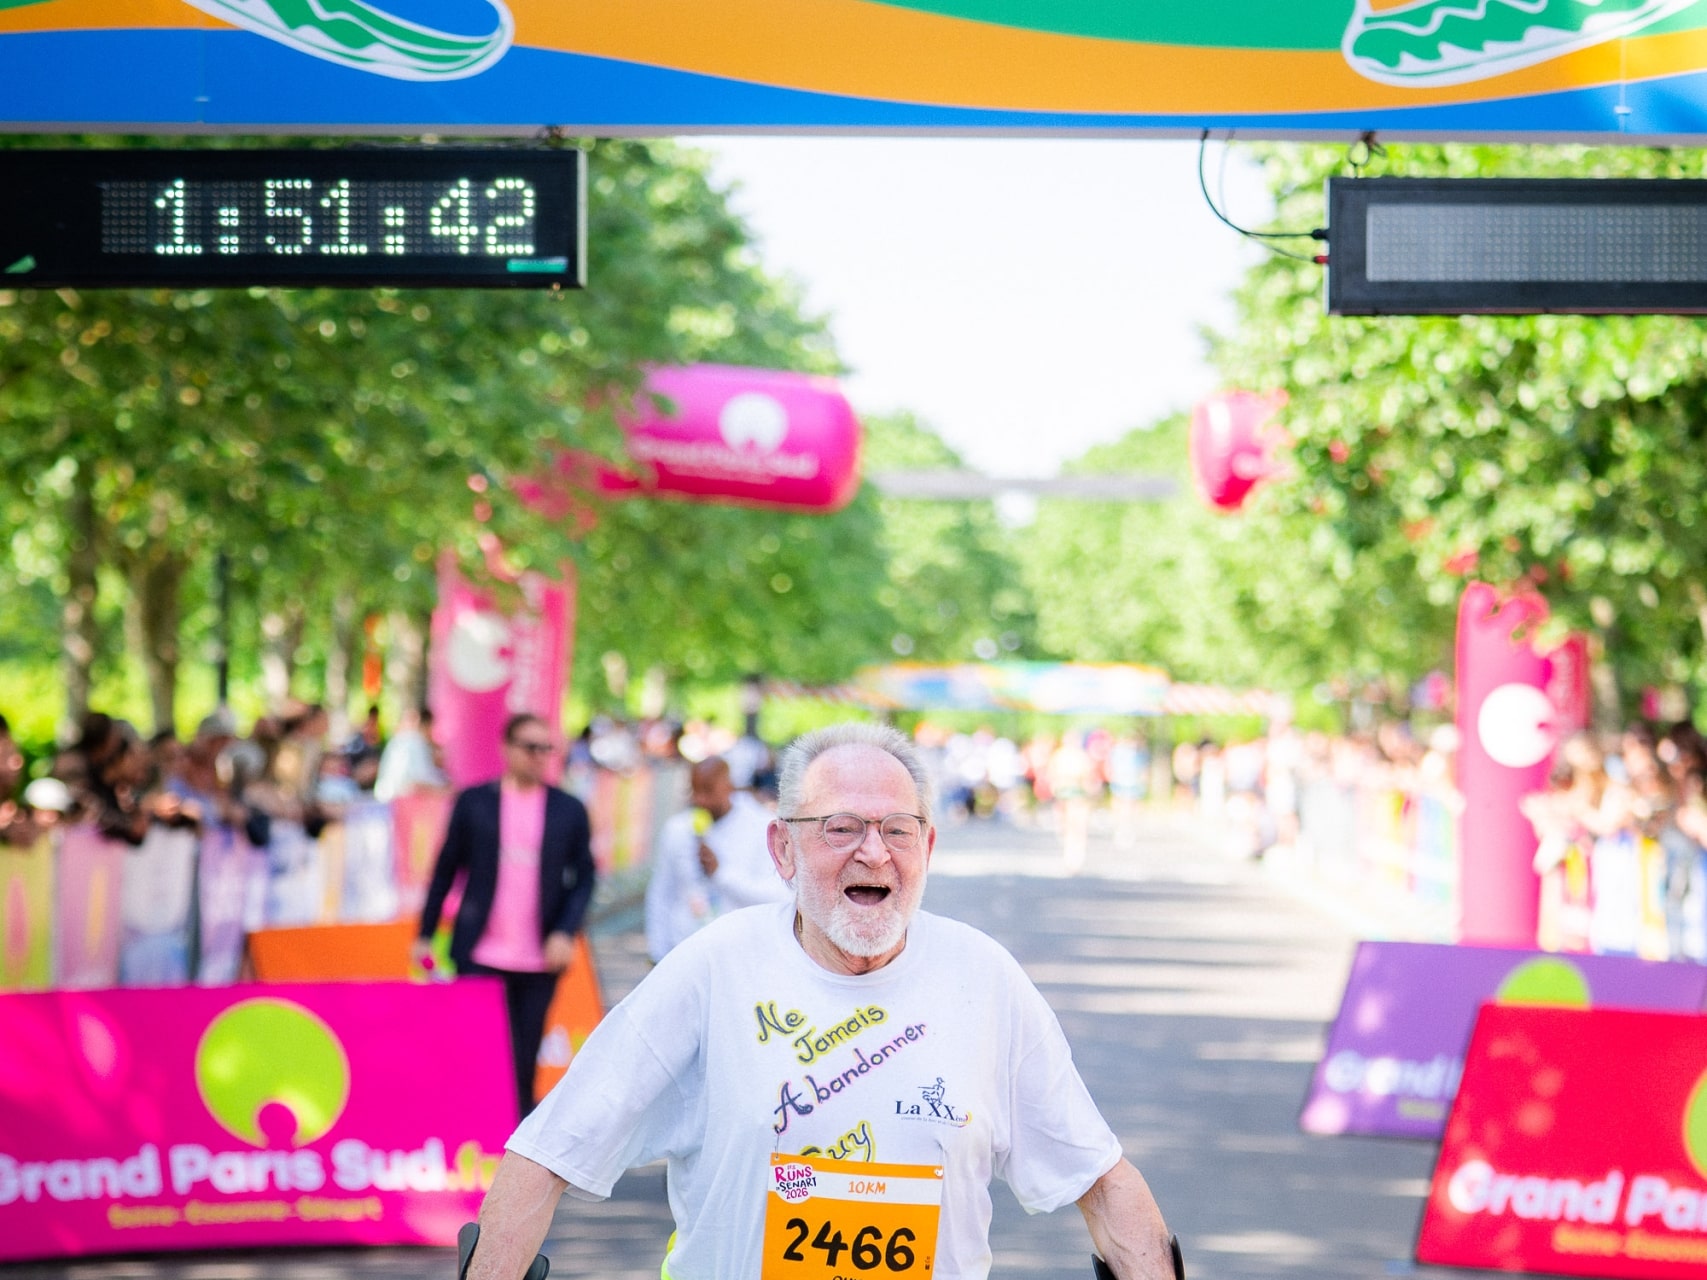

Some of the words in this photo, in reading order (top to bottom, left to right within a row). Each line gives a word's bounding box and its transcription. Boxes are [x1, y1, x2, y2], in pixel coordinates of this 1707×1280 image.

[155, 179, 535, 255] 1:51:42
[755, 1003, 805, 1042] Ne
[794, 1007, 885, 1063] Jamais
[773, 1023, 927, 1134] Abandonner
[895, 1100, 921, 1115] La
[801, 1123, 871, 1162] uy
[168, 1143, 325, 1195] Paris
[775, 1166, 812, 1183] RUNS
[785, 1187, 808, 1200] 2026
[1449, 1159, 1624, 1224] Grand
[783, 1218, 916, 1272] 2466
